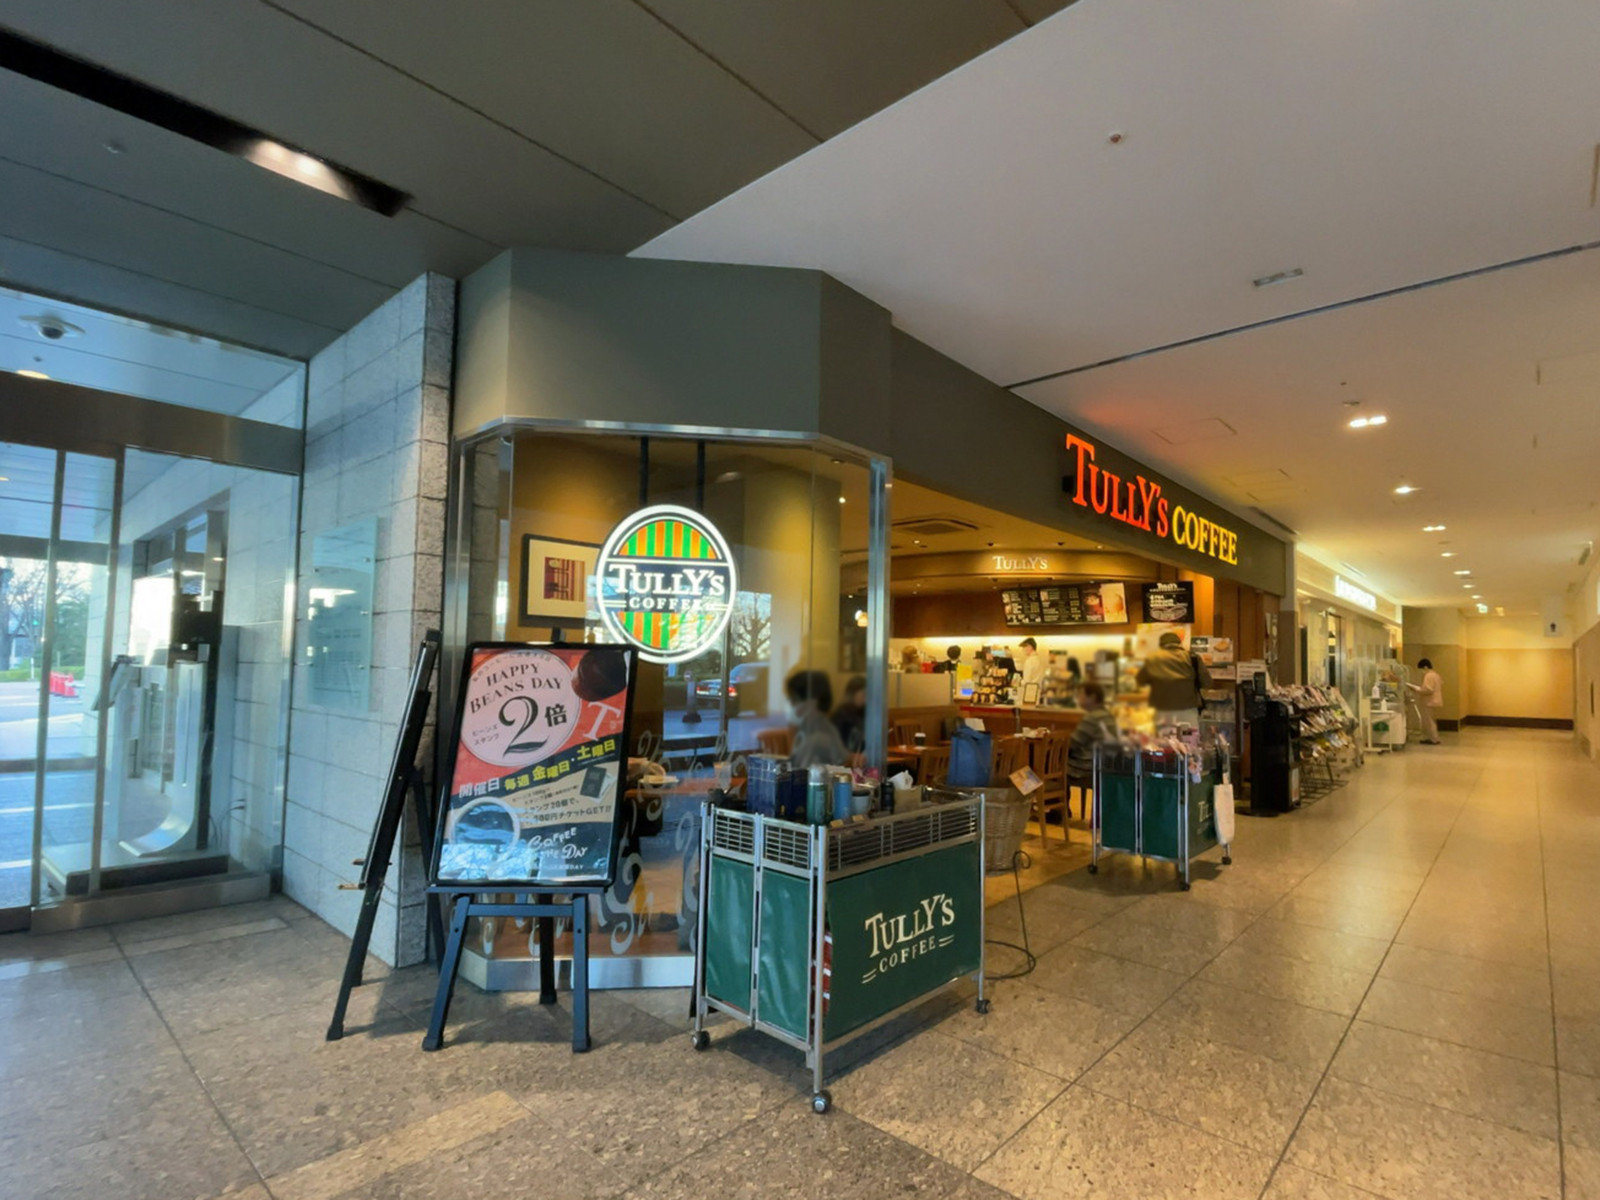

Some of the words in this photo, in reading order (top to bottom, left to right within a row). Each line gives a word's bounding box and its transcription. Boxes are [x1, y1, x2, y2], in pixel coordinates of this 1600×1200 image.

[1066, 433, 1168, 538] TULLY'S
[1172, 505, 1238, 565] COFFEE
[992, 555, 1048, 570] TULLY'S
[608, 564, 725, 596] TULLY'S
[629, 597, 703, 611] COFFEE
[486, 663, 541, 687] HAPPY
[470, 681, 525, 714] BEANS
[531, 677, 563, 690] DAY
[864, 893, 956, 959] TULLY'S
[879, 935, 937, 973] COFFEE
